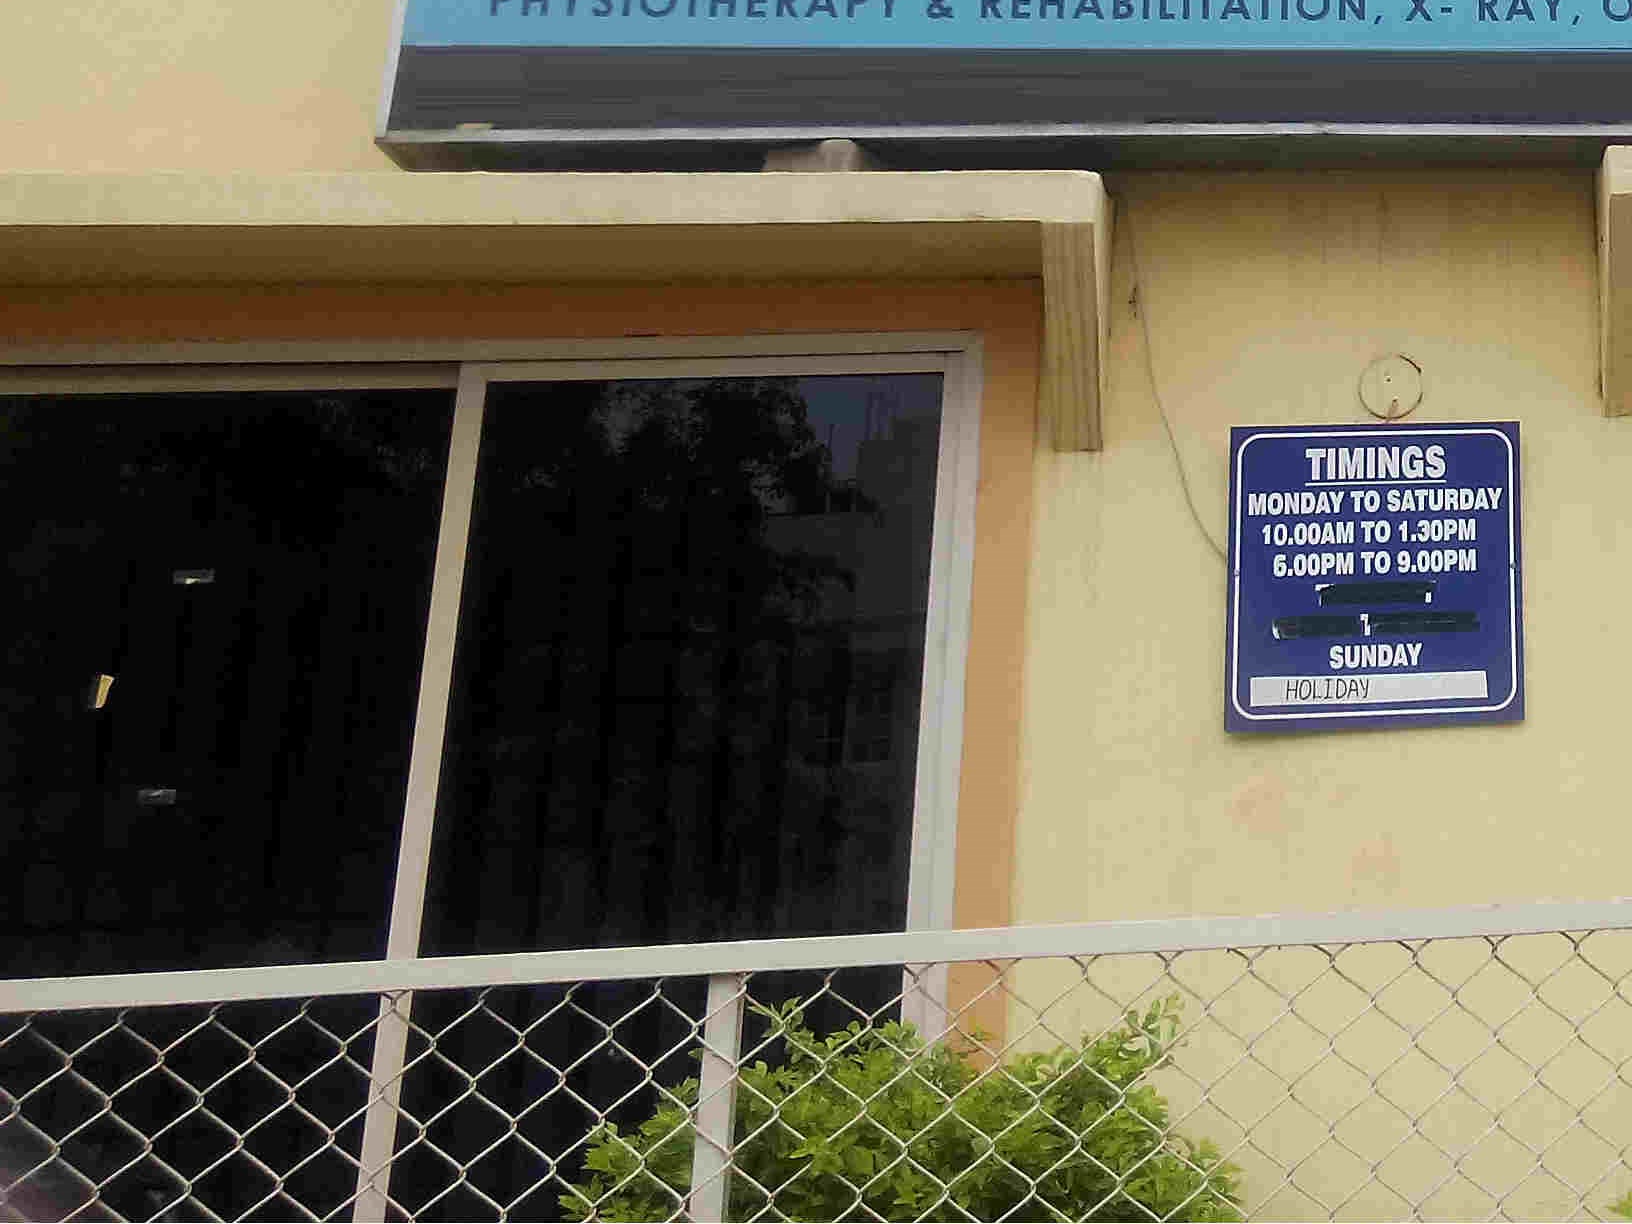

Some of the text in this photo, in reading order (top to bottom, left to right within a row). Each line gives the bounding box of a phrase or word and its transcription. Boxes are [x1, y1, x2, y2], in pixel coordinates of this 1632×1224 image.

[1306, 445, 1446, 480] TIMINGS
[1249, 488, 1502, 515] MONDAY TO SATURDAY
[1262, 519, 1475, 545] 10.00AM TO 1.30PM
[1274, 549, 1476, 577] 6.00PM TO 9.00PM
[1330, 643, 1422, 669] SUNDAY
[1286, 678, 1369, 700] HOLIDAY
